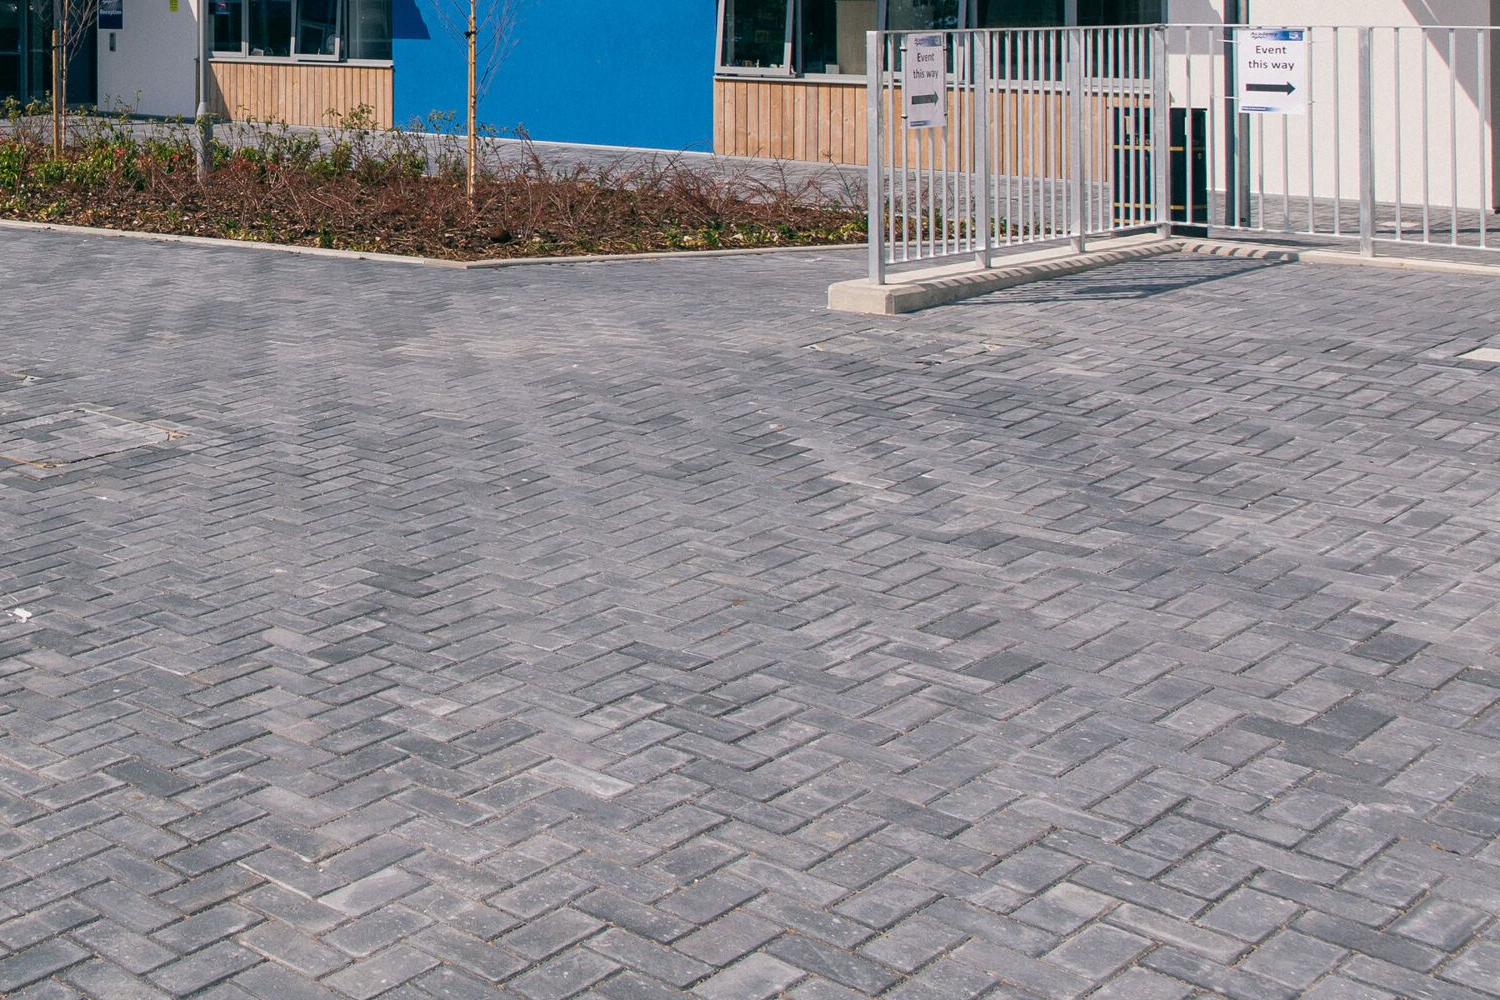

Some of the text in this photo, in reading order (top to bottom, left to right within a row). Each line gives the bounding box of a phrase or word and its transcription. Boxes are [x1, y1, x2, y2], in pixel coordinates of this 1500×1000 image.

[1255, 45, 1287, 54] Event
[917, 53, 934, 62] Event
[1248, 60, 1295, 71] this way
[913, 68, 938, 79] this way
